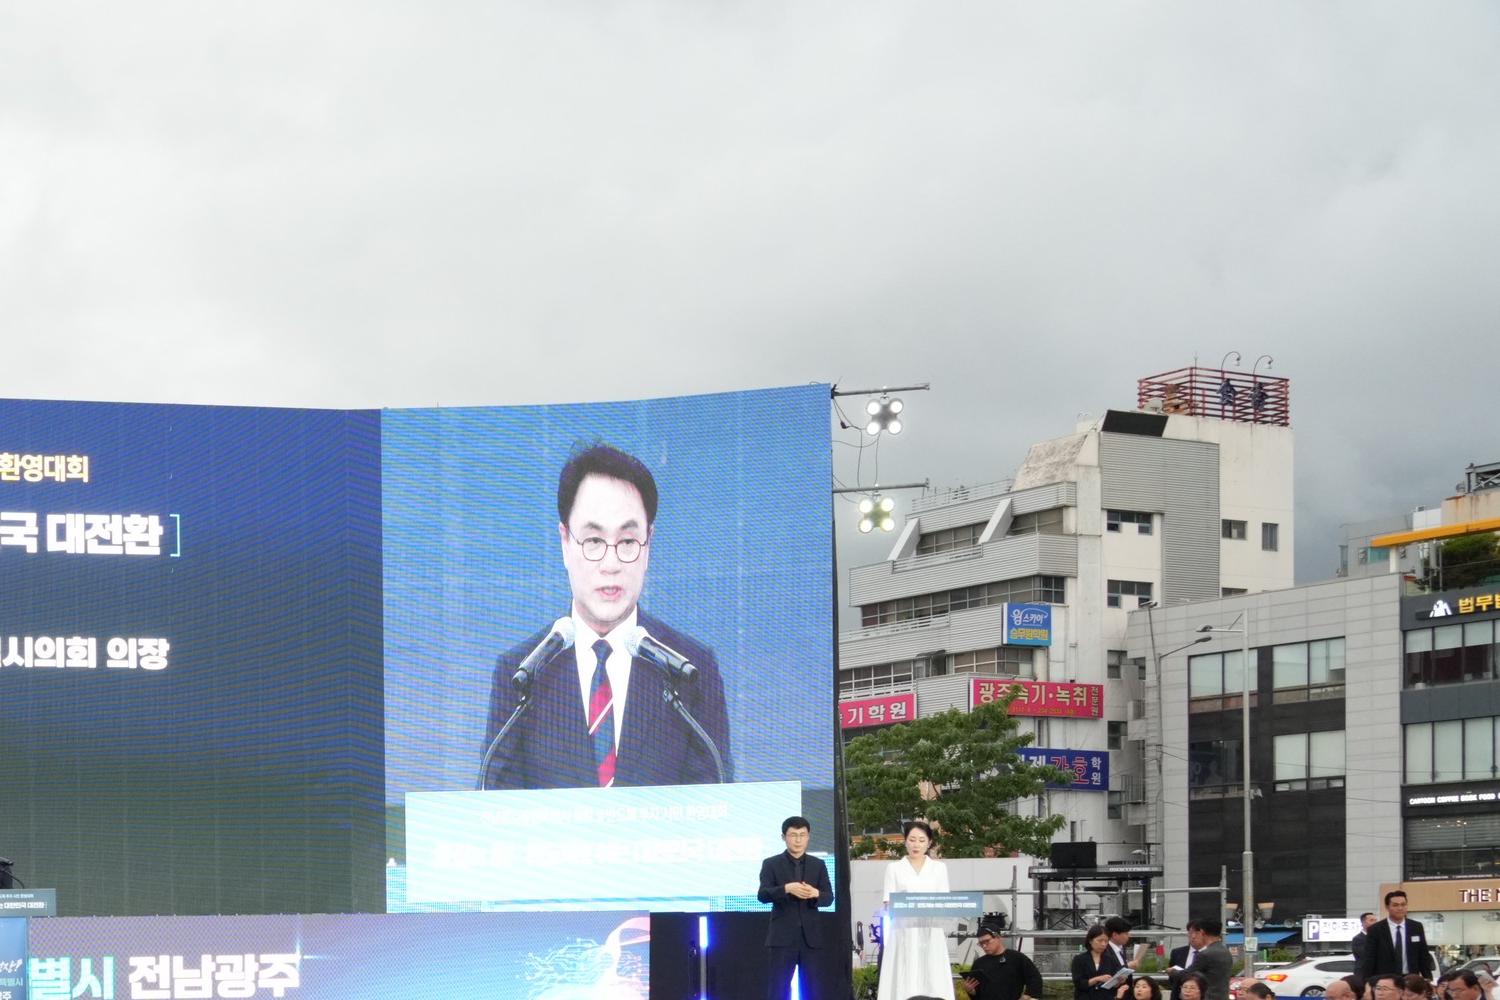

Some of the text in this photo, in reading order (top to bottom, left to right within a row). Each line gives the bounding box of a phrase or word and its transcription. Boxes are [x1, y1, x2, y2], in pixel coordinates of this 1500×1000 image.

[106, 637, 171, 671] 의장
[839, 701, 907, 724] 기학원
[1458, 888, 1492, 903] THE
[128, 952, 301, 1000] 전남광주
